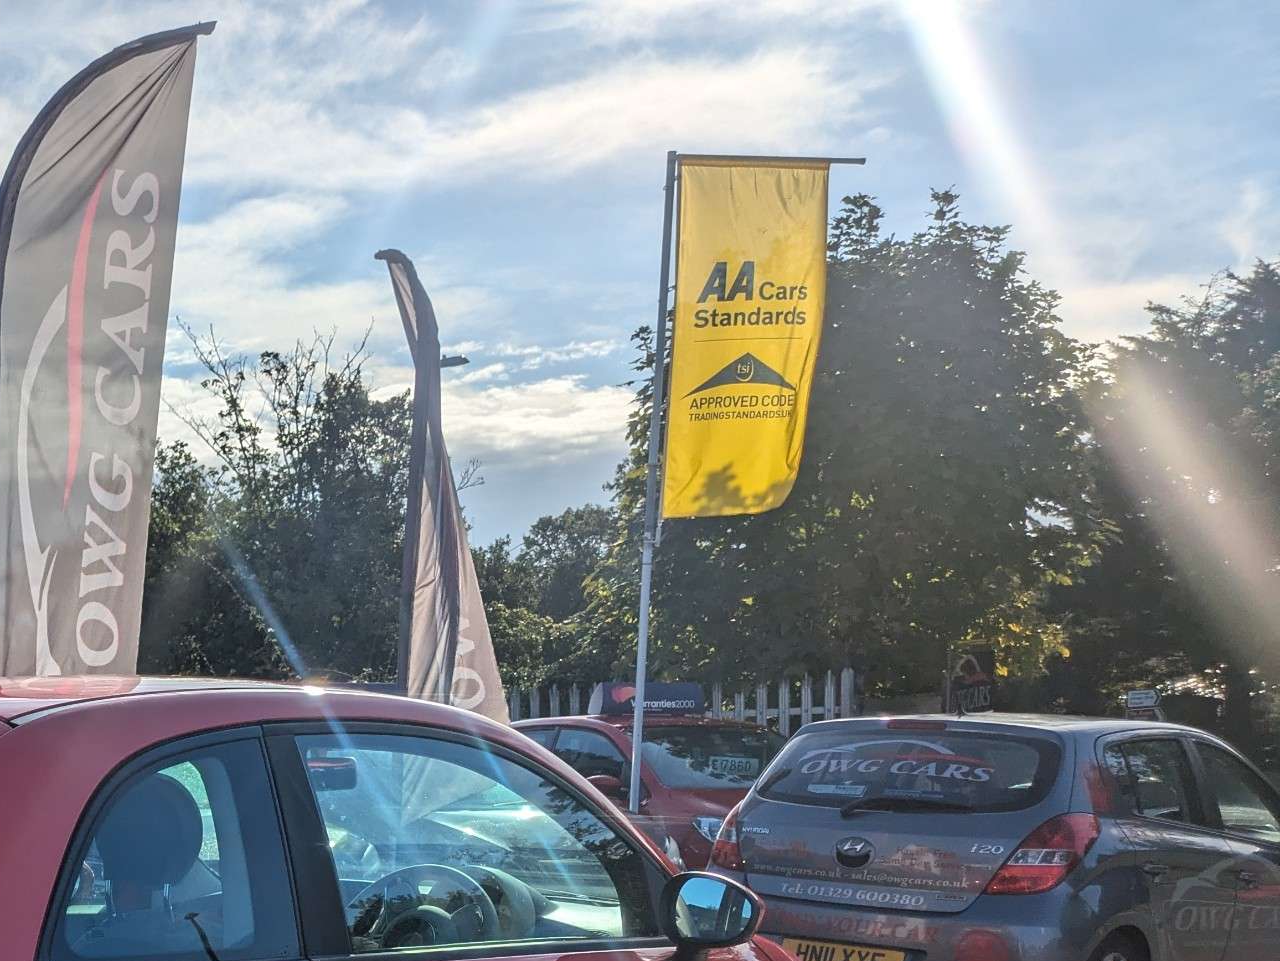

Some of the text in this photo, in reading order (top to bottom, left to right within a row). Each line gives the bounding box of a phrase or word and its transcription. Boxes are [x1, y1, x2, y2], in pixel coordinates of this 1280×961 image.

[696, 260, 808, 304] AA Cars
[694, 307, 807, 329] Standards
[689, 394, 795, 410] APPROVED CODE
[76, 169, 160, 667] OWG CARS
[801, 757, 995, 782] OWG CARS
[970, 843, 1005, 855] i20
[851, 869, 970, 889] sales@owgcars.co.uk
[807, 885, 853, 899] 01329
[856, 889, 924, 906] 600380
